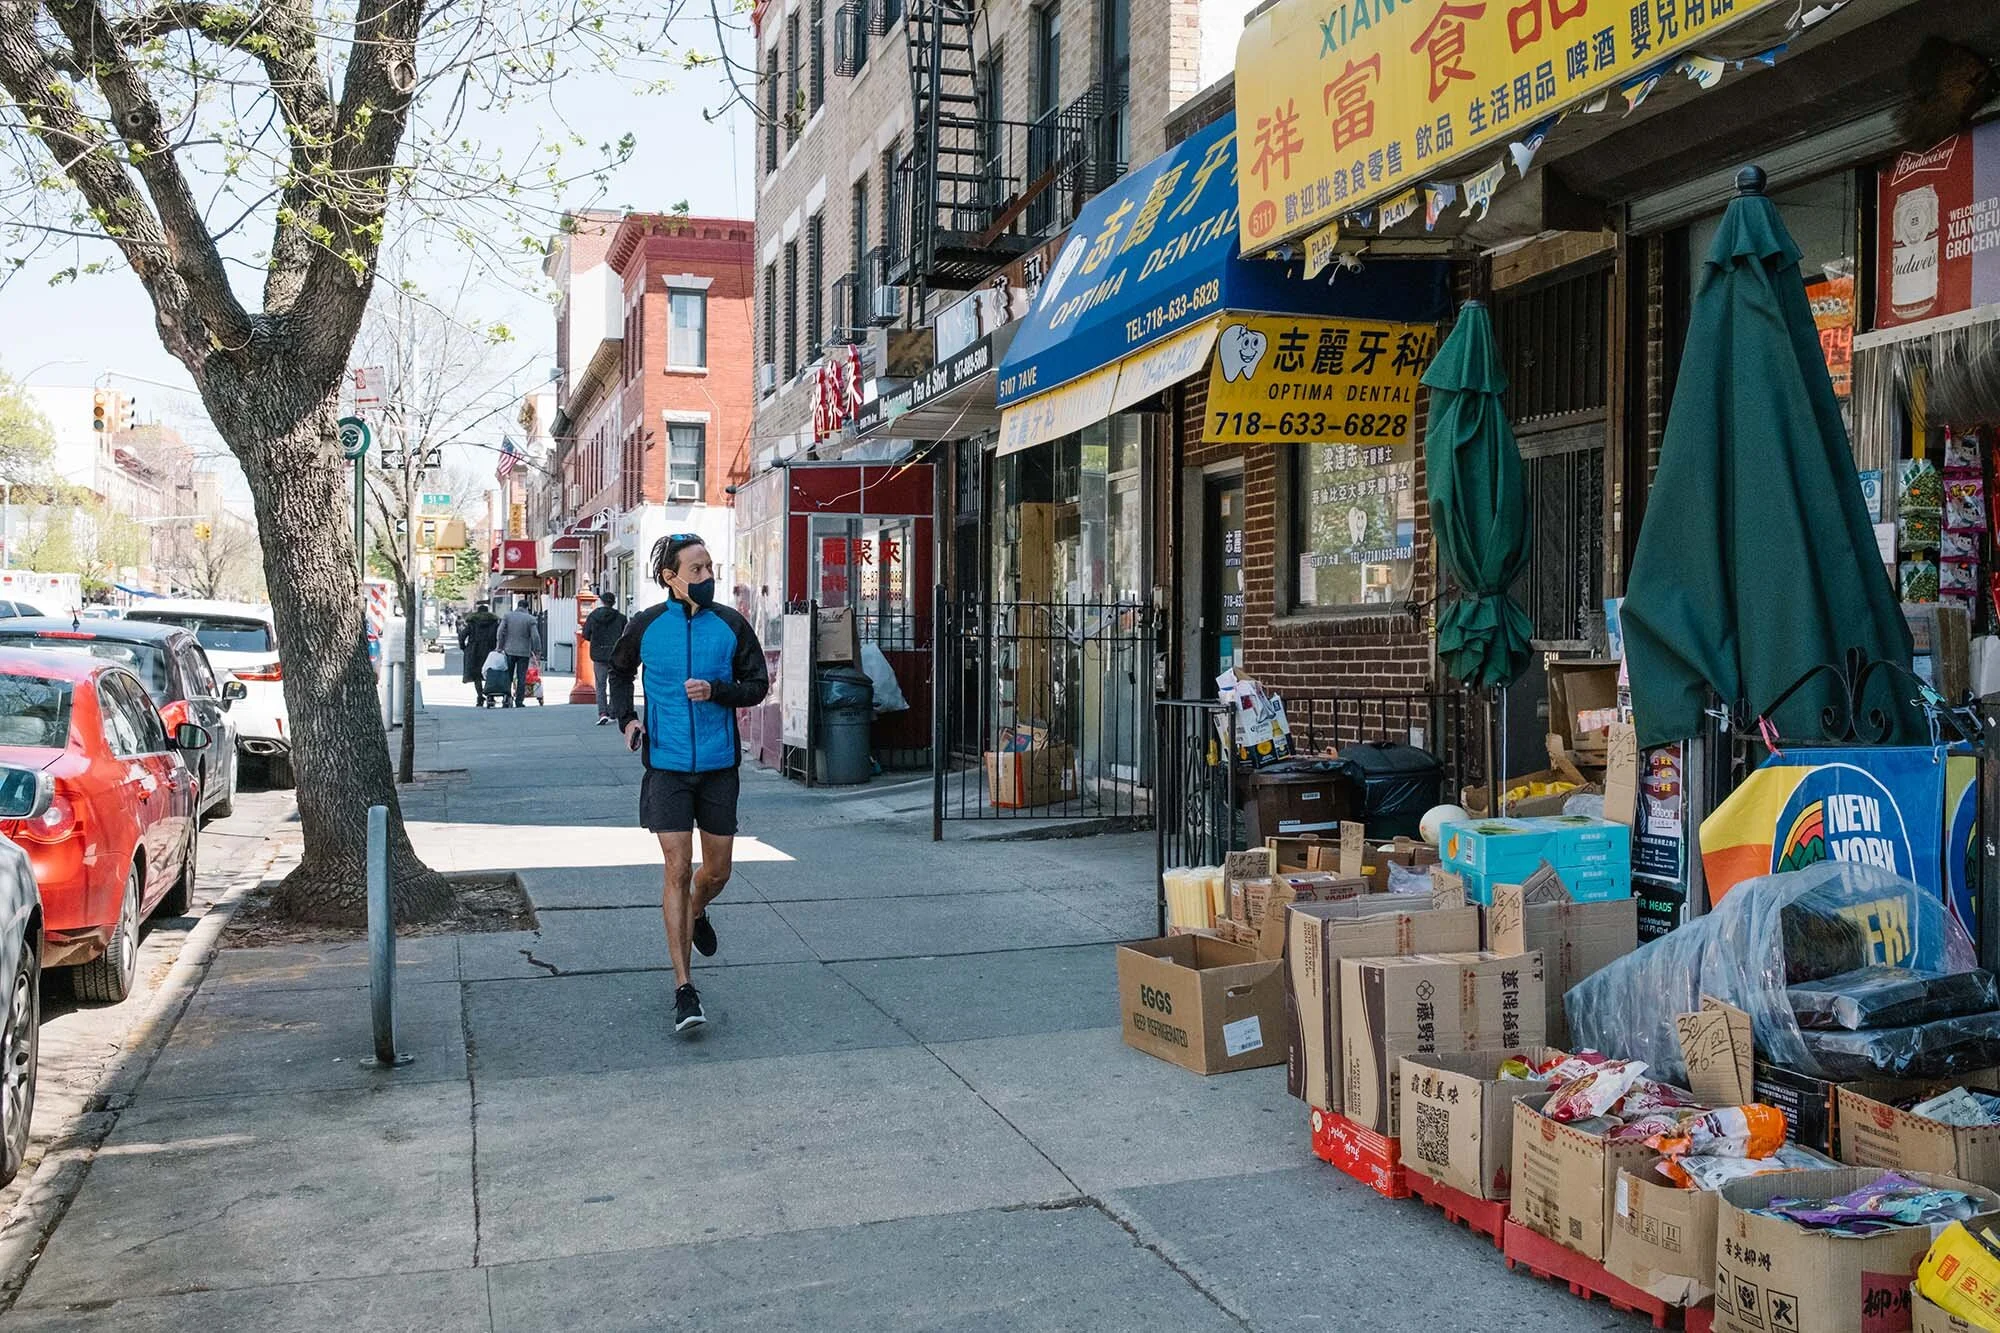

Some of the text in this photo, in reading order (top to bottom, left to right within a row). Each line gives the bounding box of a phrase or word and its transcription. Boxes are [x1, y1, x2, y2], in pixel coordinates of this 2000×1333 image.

[1319, 0, 1410, 60] XIAN
[1416, 113, 1454, 160] 飲品
[1468, 60, 1556, 136] 生活用品
[1566, 25, 1616, 82] 啤酒
[1898, 147, 1953, 176] Budweiser
[1078, 131, 1239, 276] 志麗牙
[1468, 180, 1492, 199] PLAY
[1254, 208, 1274, 237] 5111
[1384, 198, 1408, 221] PLAY
[1947, 208, 2000, 240] XIANGFU
[1950, 196, 1998, 221] WELCOME TO
[1312, 231, 1332, 254] PLAY
[1945, 228, 2000, 260] GROCERY
[1050, 267, 1127, 330] OPTIMA
[1137, 207, 1239, 283] DENTAL
[1126, 279, 1220, 343] TEL:718-633-6828
[1273, 326, 1427, 378] 志麗牙科
[913, 380, 925, 402] Tea
[1268, 383, 1410, 402] OPTIMA DENTAL
[1215, 412, 1408, 437] 718-633-6828
[1827, 794, 1881, 834] NEW
[1141, 984, 1172, 1015] EGGS
[1133, 1012, 1189, 1048] KEEP REFRIGERATED
